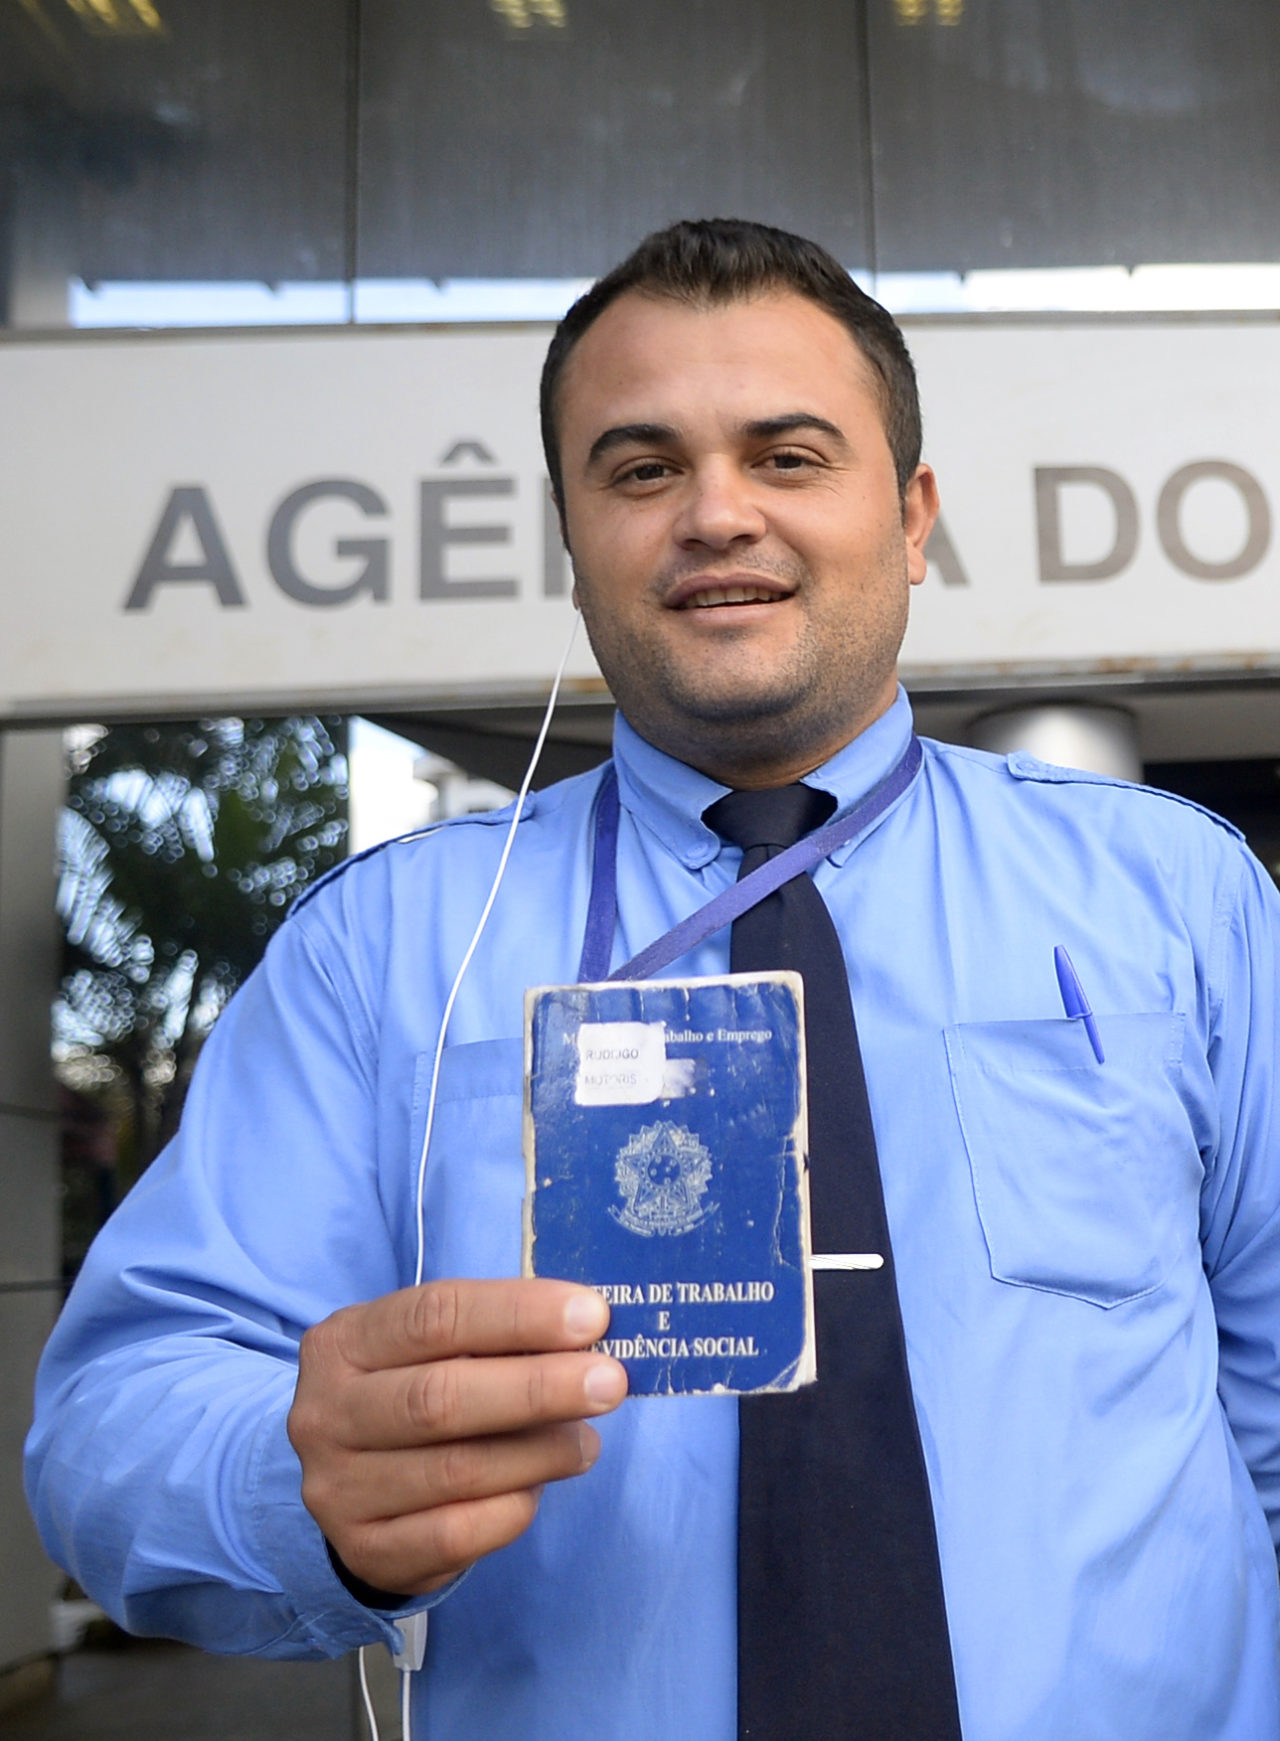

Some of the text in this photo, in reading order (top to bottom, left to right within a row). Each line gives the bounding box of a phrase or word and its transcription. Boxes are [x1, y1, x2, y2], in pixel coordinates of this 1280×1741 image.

[1031, 458, 1274, 587] DO
[706, 1031, 714, 1042] e
[717, 1028, 773, 1046] Emprego
[649, 1282, 674, 1305] DE
[676, 1281, 775, 1304] TRABALHO
[657, 1310, 671, 1332] E
[693, 1336, 760, 1358] SOCIAL
